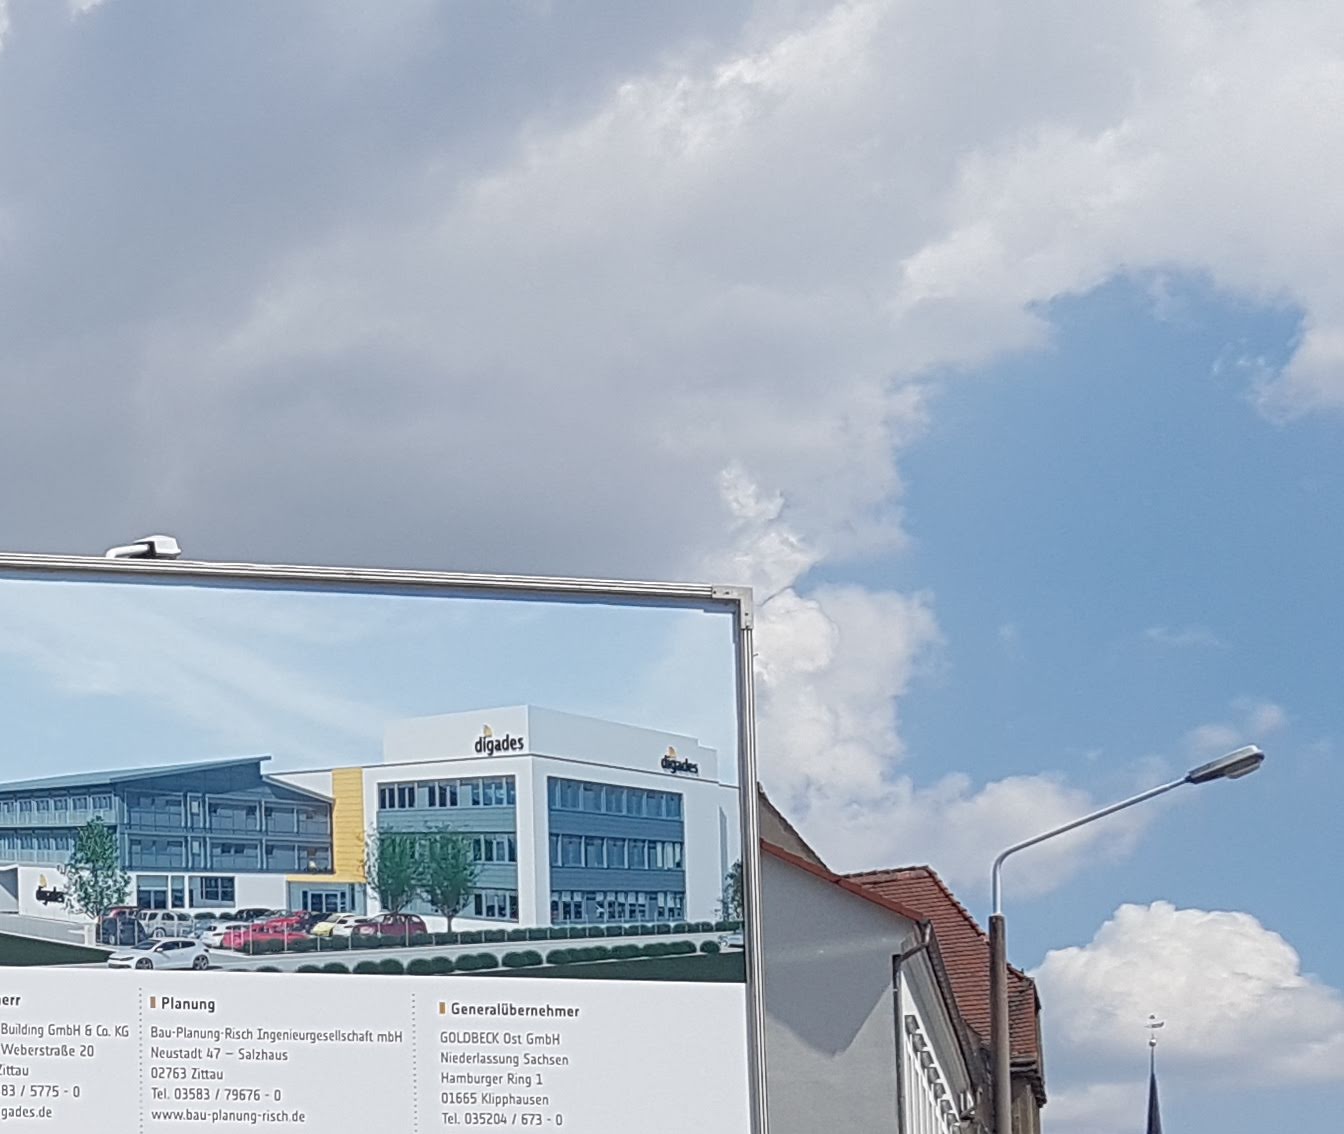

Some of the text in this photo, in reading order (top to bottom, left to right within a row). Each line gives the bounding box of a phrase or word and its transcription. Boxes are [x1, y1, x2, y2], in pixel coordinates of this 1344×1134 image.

[475, 733, 524, 756] digades
[161, 997, 215, 1013] Planung
[451, 1002, 580, 1017] Generalübernehmer
[1, 1023, 44, 1038] Building
[48, 1024, 81, 1036] GmbH
[84, 1025, 92, 1036] &
[96, 1025, 111, 1037] Co.
[114, 1025, 129, 1037] KG
[150, 1026, 403, 1044] Bau-Planung-Risch Ingenieurgesellschaft mbH
[440, 1032, 560, 1045] GOLDBECK Ost GmbH
[1, 1042, 75, 1057] Weberstraße
[79, 1045, 95, 1057] 20
[150, 1047, 202, 1059] Neustadt
[206, 1048, 221, 1059] 47
[238, 1048, 288, 1061] Salzhaus
[440, 1052, 569, 1067] Niederlassung Sachsen
[150, 1067, 224, 1080] 02763 Zittau
[441, 1072, 543, 1087] Hamburger Ring 1
[20, 1085, 26, 1097] /
[30, 1085, 59, 1097] 5775
[73, 1086, 80, 1098] 0
[151, 1087, 170, 1100] Tel.
[174, 1087, 211, 1100] 03583
[214, 1088, 221, 1101] /
[224, 1088, 261, 1101] 79676
[274, 1089, 281, 1101] 0
[441, 1092, 549, 1108] 01665 Klipphausen
[151, 1108, 306, 1125] www.bau-planung-risch.de
[442, 1112, 460, 1125] Tel.
[464, 1113, 507, 1126] 035204
[511, 1113, 517, 1126] /
[521, 1114, 542, 1126] 673
[556, 1114, 563, 1126] 0
